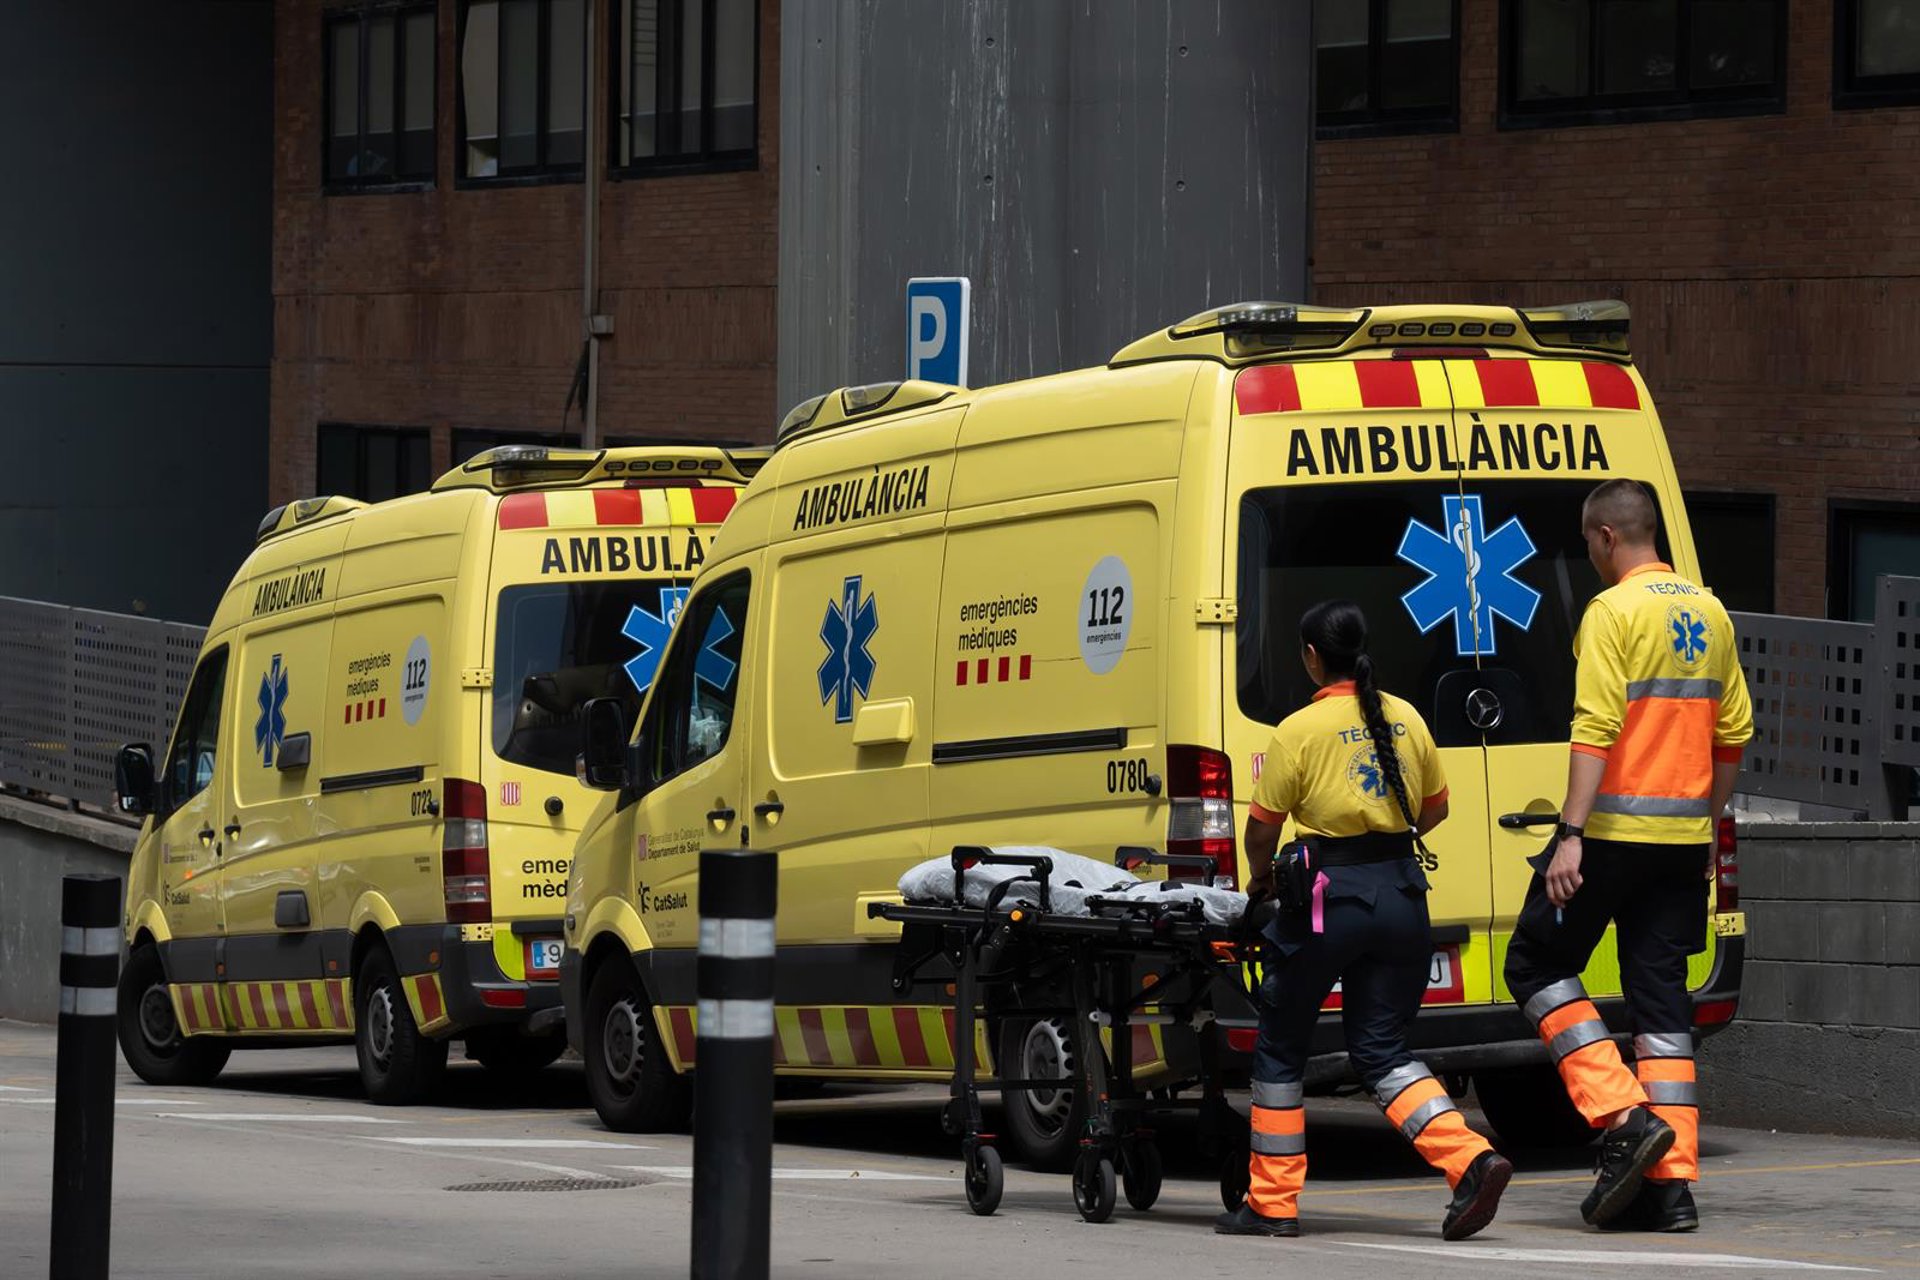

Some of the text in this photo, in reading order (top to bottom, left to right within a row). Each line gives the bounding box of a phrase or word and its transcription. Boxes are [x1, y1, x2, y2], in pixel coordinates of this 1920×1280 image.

[911, 296, 947, 380] P
[1286, 413, 1610, 476] AMBULÀNCIA
[793, 465, 930, 531] AMBULÀNCIA
[541, 528, 714, 574] AMBULÀ
[252, 565, 326, 616] AMBULÀNCIA
[1088, 586, 1124, 627] 112
[960, 593, 1038, 624] emergències
[958, 627, 1017, 653] mèdiques
[348, 651, 391, 675] emergències
[406, 658, 427, 690] 112
[347, 678, 379, 698] mèdiques
[1338, 722, 1406, 745] TÈCC
[1107, 758, 1147, 793] 0780
[653, 893, 688, 912] CatSalut
